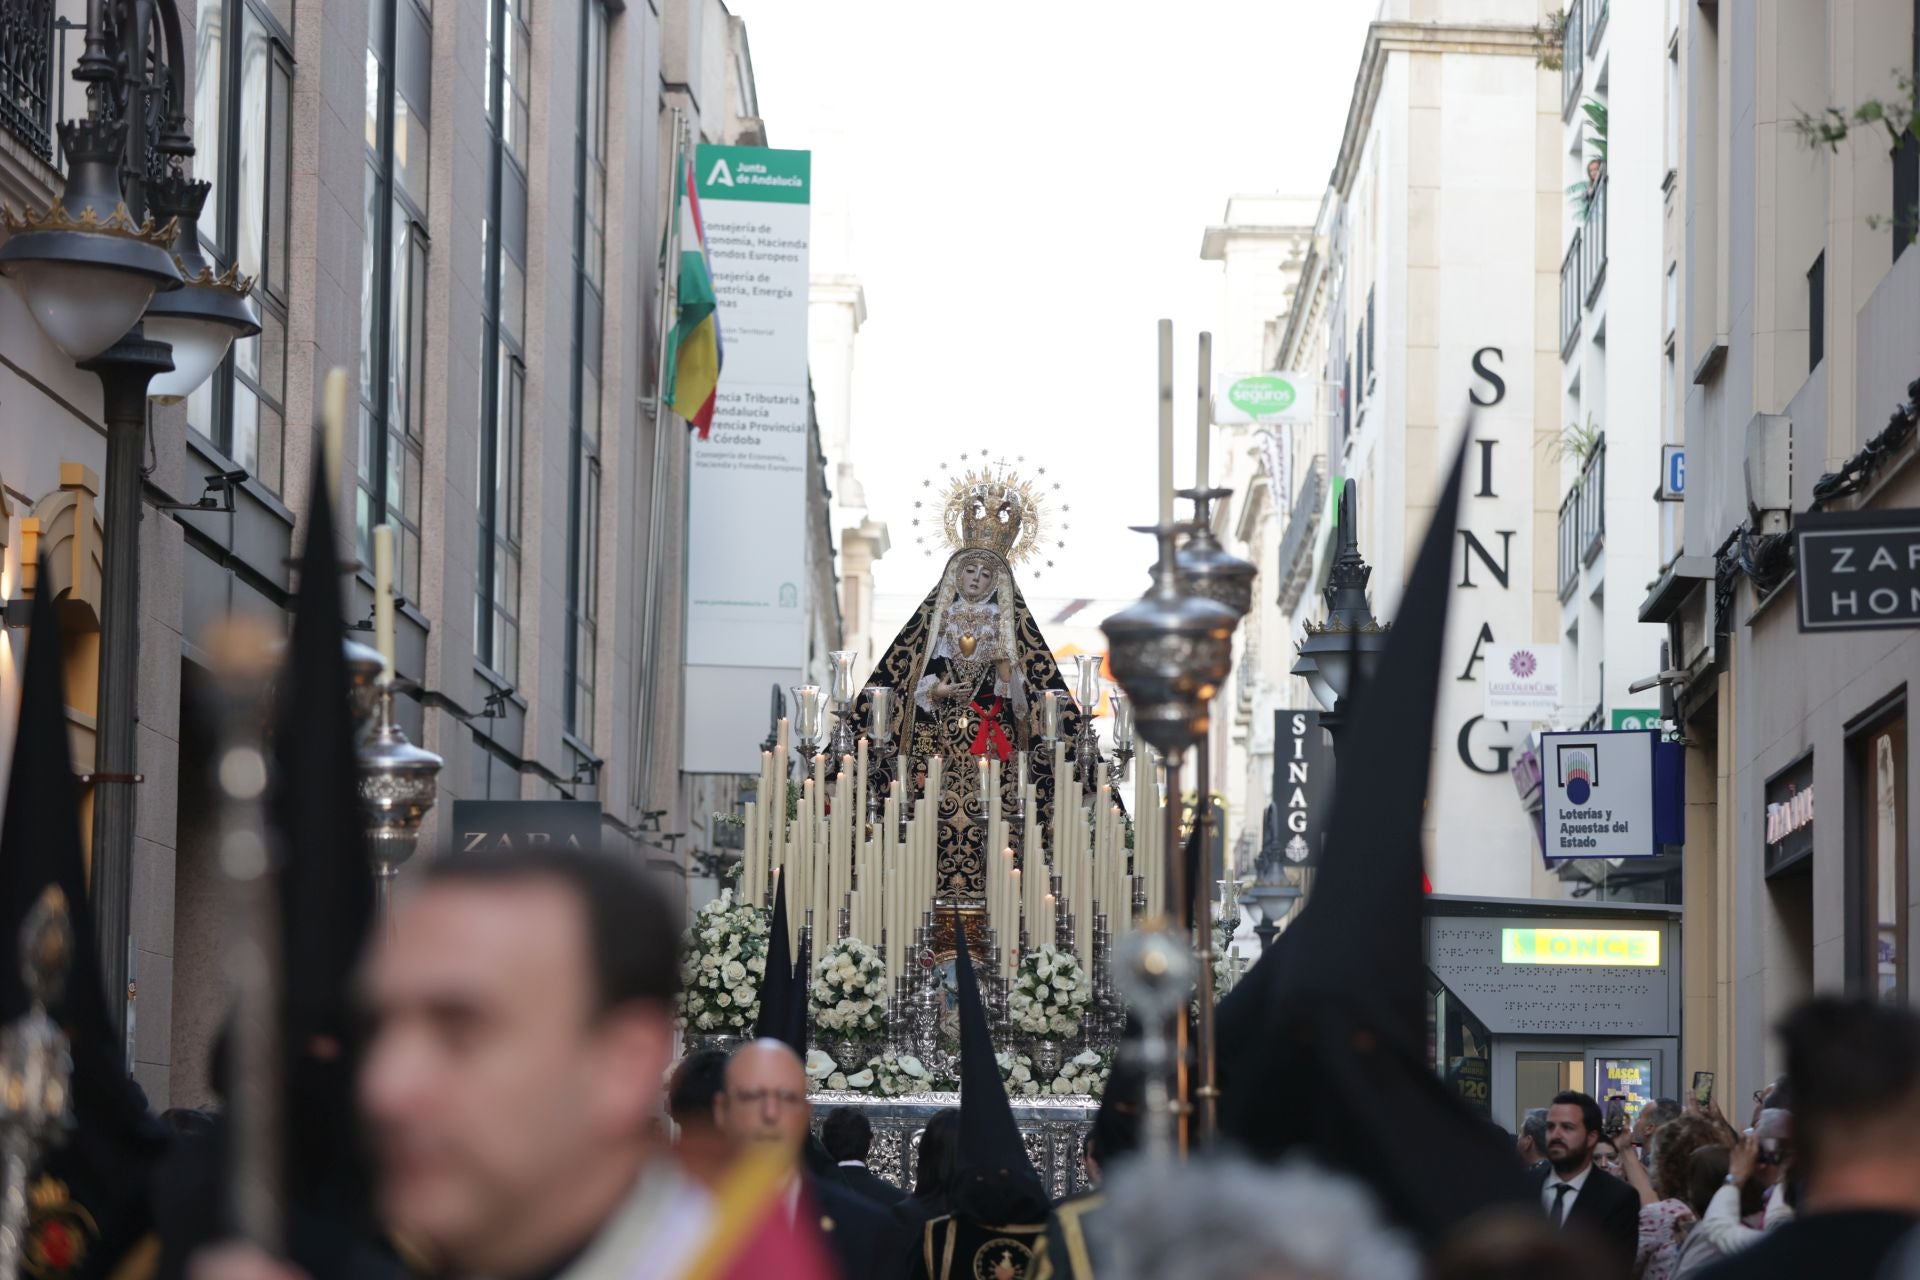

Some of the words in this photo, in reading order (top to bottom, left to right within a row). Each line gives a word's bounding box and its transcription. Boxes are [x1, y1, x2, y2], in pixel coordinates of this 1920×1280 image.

[736, 162, 767, 173] Junta
[736, 174, 749, 184] de
[751, 175, 802, 187] Andalucía
[704, 222, 756, 233] onsejería
[758, 224, 771, 233] de
[707, 237, 756, 247] onomía,
[758, 239, 808, 249] Hacienda
[749, 251, 799, 262] Europeos
[712, 272, 754, 283] nsejería
[757, 274, 770, 283] de
[714, 284, 749, 296] ustria,
[753, 287, 793, 298] Energía
[720, 299, 737, 308] nas
[715, 393, 741, 403] ncia
[745, 393, 800, 405] Tributaria
[1233, 389, 1290, 404] seguros
[712, 421, 747, 431] rencia
[750, 421, 805, 433] Provincial
[714, 433, 761, 445] Córdoba
[1457, 346, 1517, 775] SINAG
[1287, 713, 1309, 832] SINAG
[1559, 808, 1603, 820] Loterías
[1606, 810, 1612, 821] y
[1560, 823, 1610, 836] Apuestas
[1612, 821, 1629, 833] del
[1560, 836, 1597, 848] Estado
[1550, 936, 1644, 958] ONCE
